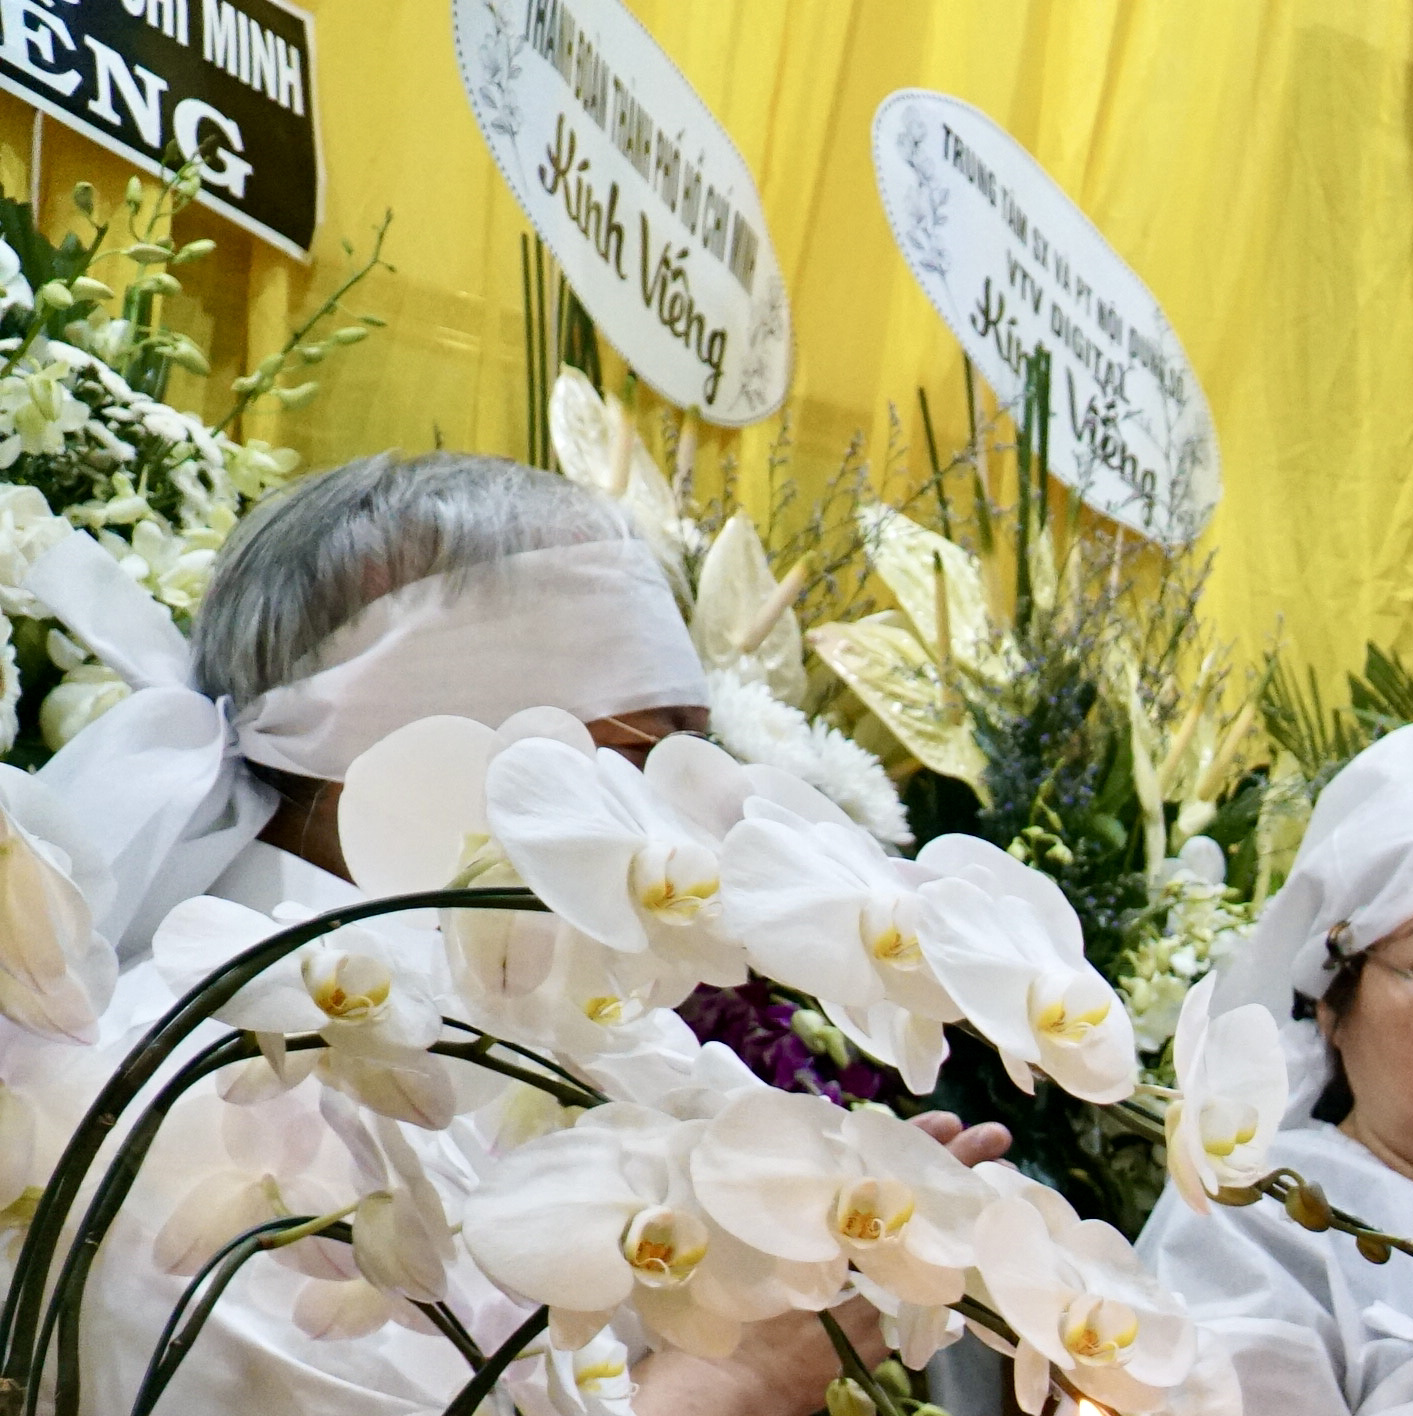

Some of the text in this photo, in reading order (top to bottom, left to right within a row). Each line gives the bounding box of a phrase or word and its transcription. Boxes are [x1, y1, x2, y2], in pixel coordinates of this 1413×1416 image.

[202, 0, 306, 117] MINH
[942, 123, 998, 208] TRUNG
[538, 112, 728, 406] Kính Viếng
